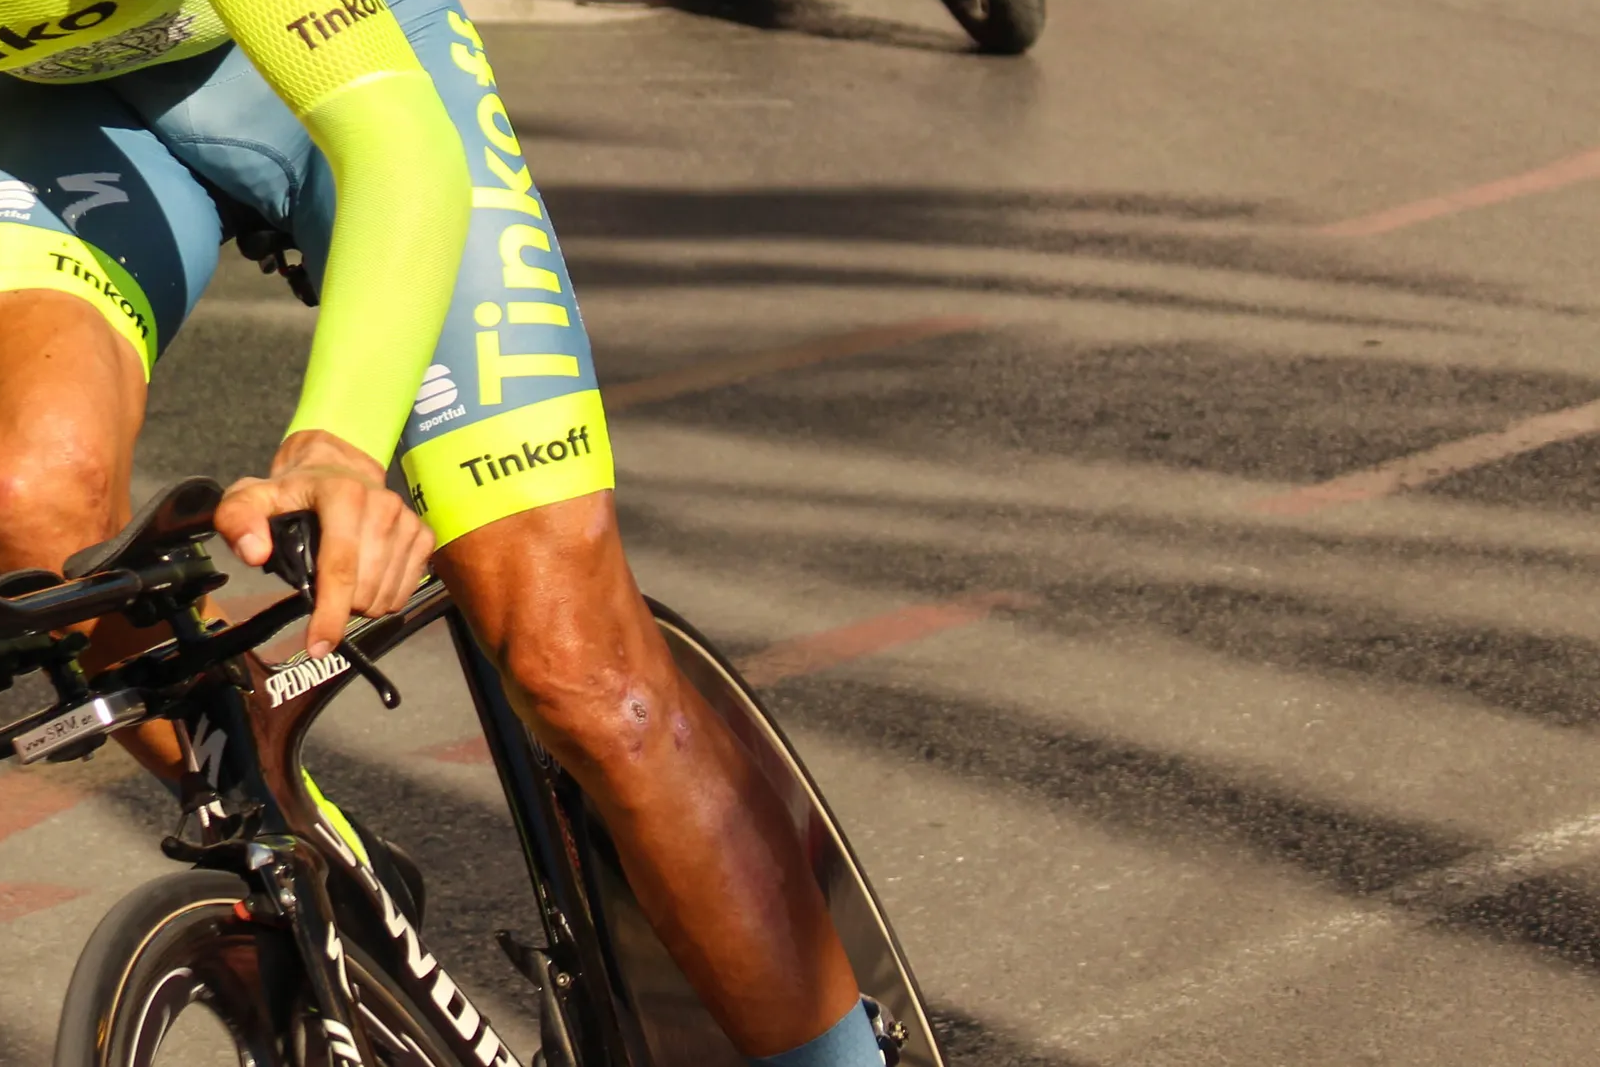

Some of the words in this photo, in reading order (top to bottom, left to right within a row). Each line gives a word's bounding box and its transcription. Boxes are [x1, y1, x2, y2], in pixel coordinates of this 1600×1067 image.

[447, 9, 580, 406] Tinkoff
[418, 404, 467, 432] sportful
[460, 425, 592, 488] Tinkoff
